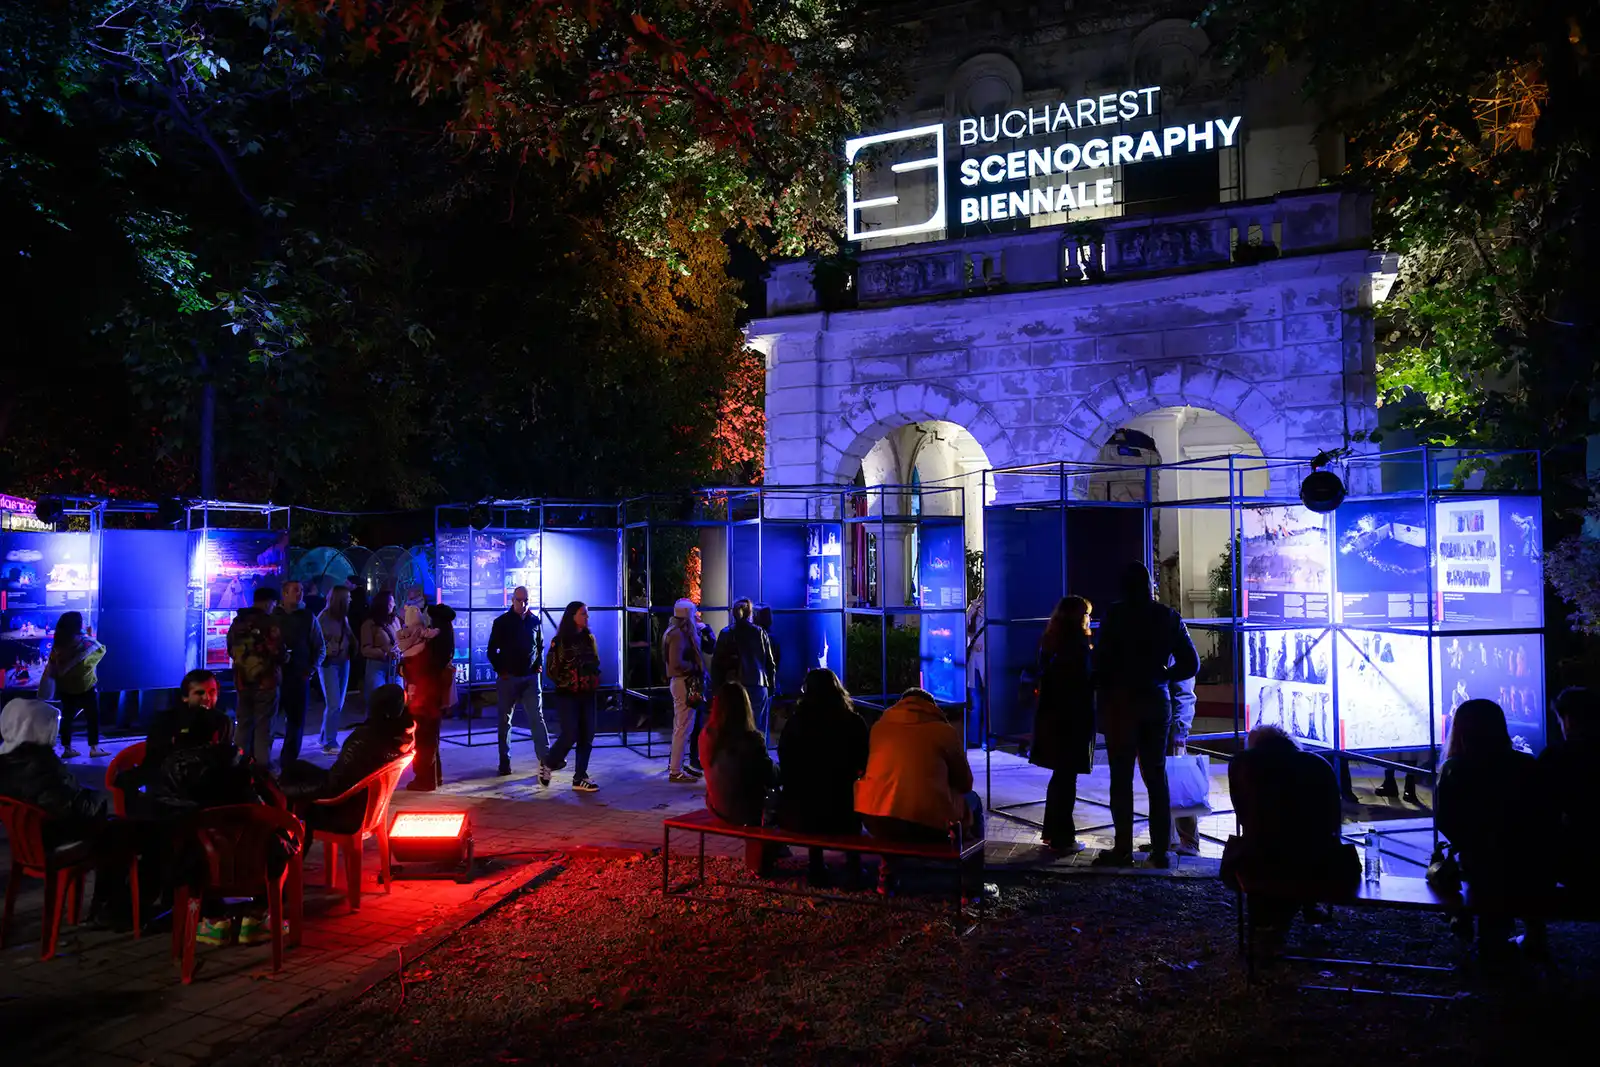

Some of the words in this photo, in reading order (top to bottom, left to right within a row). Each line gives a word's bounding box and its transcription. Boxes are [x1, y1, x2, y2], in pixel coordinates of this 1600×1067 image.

[959, 86, 1162, 145] BUCHAREST
[960, 116, 1242, 187] SCENOGRAPHY
[960, 178, 1114, 224] BIENNALE
